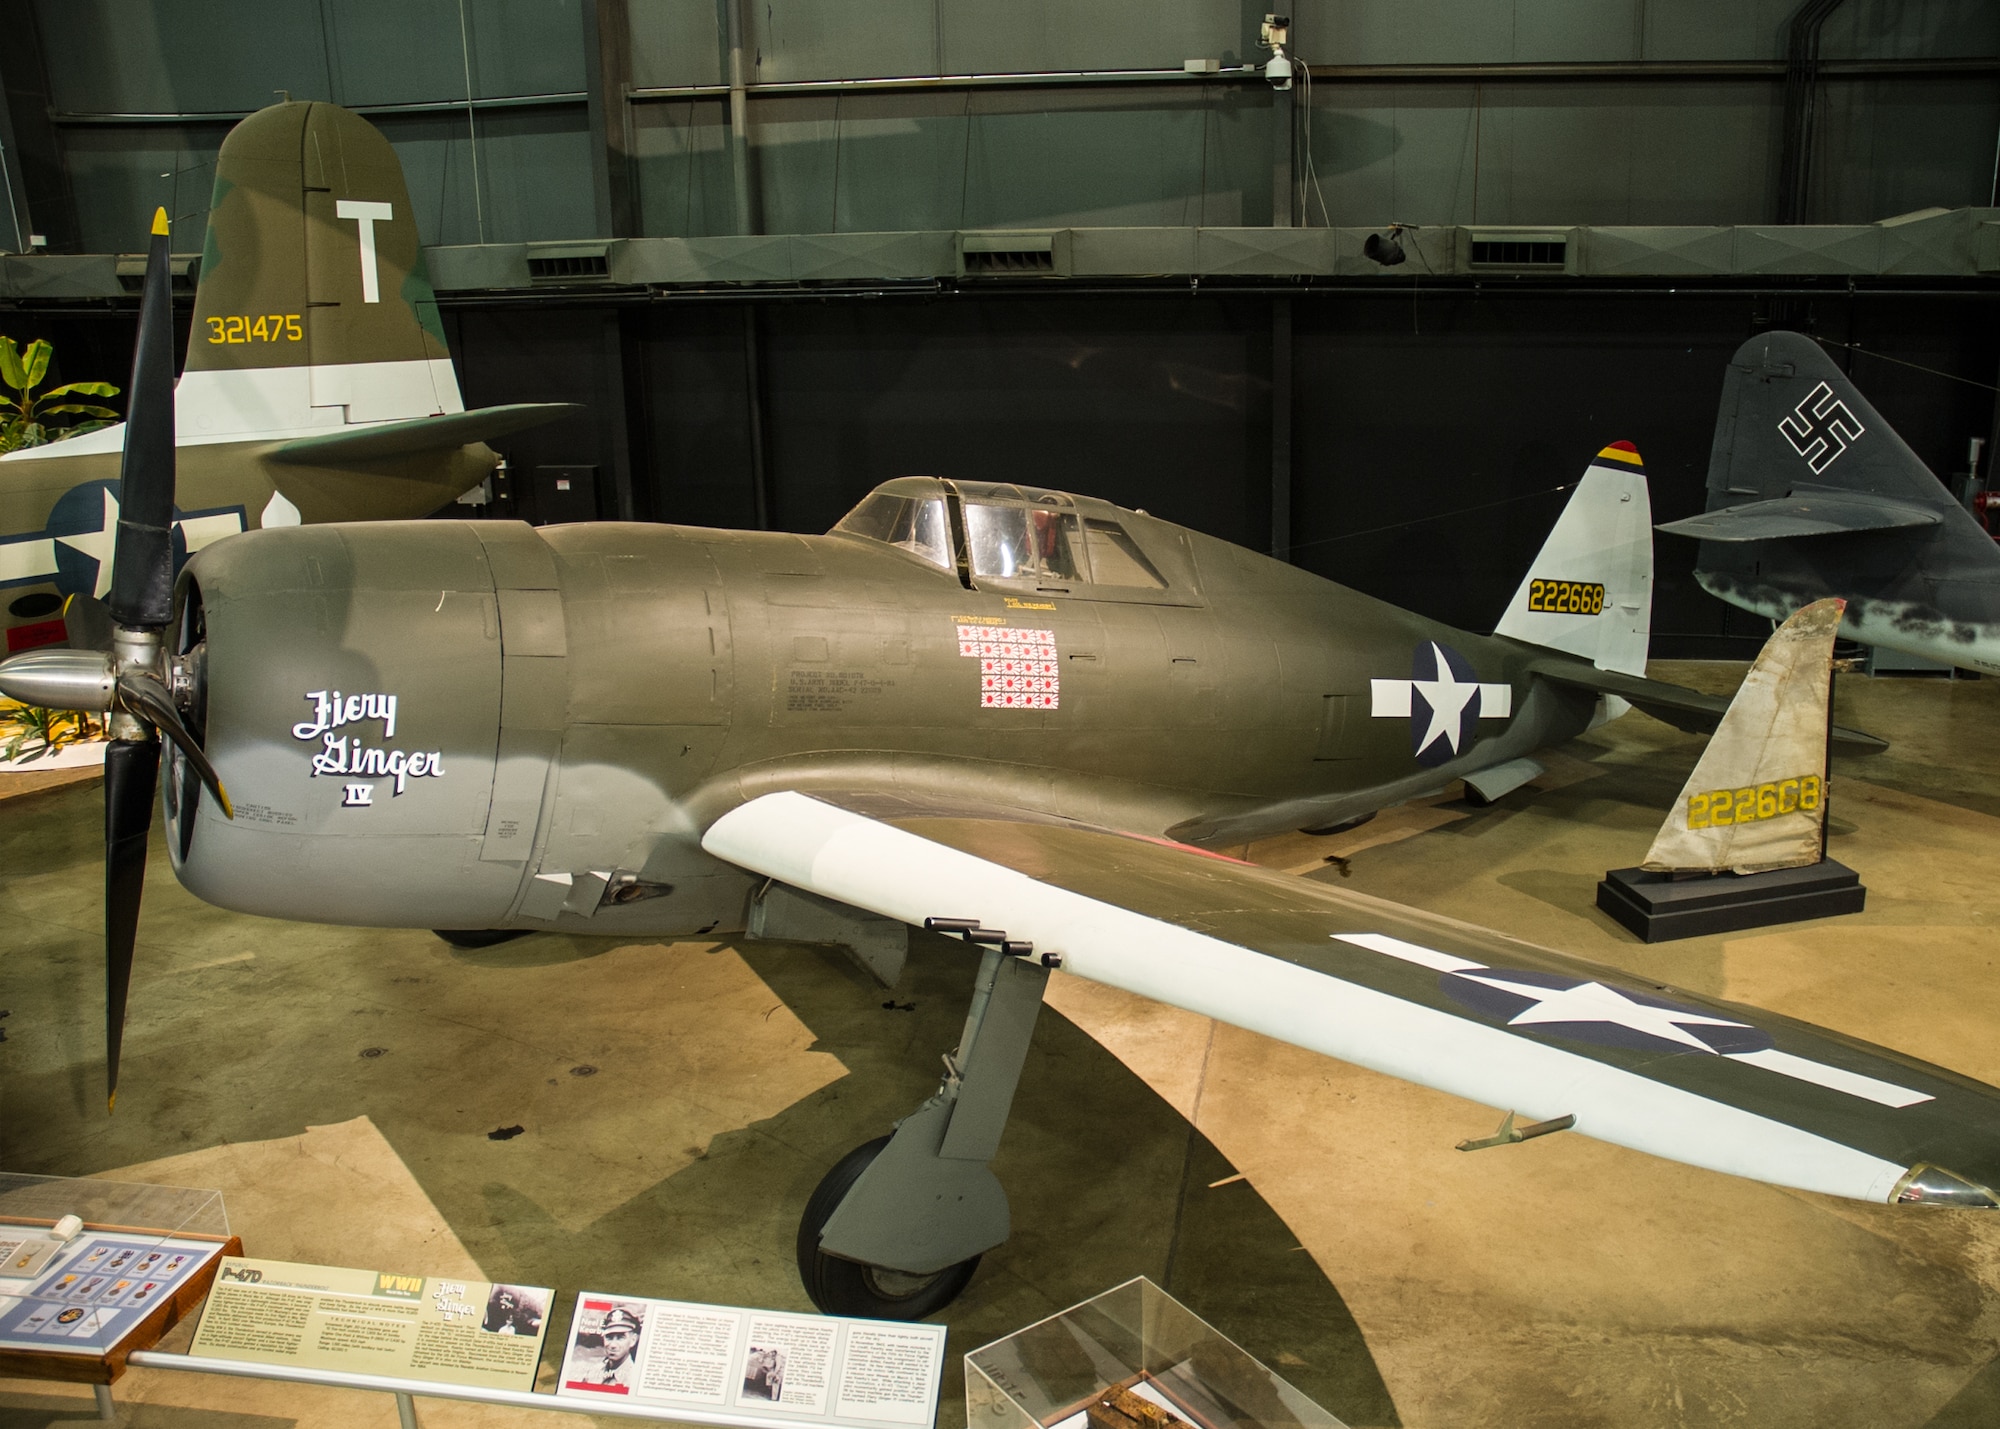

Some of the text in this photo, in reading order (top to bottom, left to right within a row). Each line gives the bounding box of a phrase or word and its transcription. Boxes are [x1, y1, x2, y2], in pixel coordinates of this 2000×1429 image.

[336, 200, 393, 304] T
[206, 314, 303, 345] 321475
[1529, 580, 1604, 614] 222668
[291, 690, 398, 741] Fiery
[311, 731, 445, 796] Ginger
[344, 783, 374, 806] IV
[1688, 775, 1820, 830] 222668
[221, 1267, 263, 1284] P-47D
[380, 1274, 423, 1293] WWII
